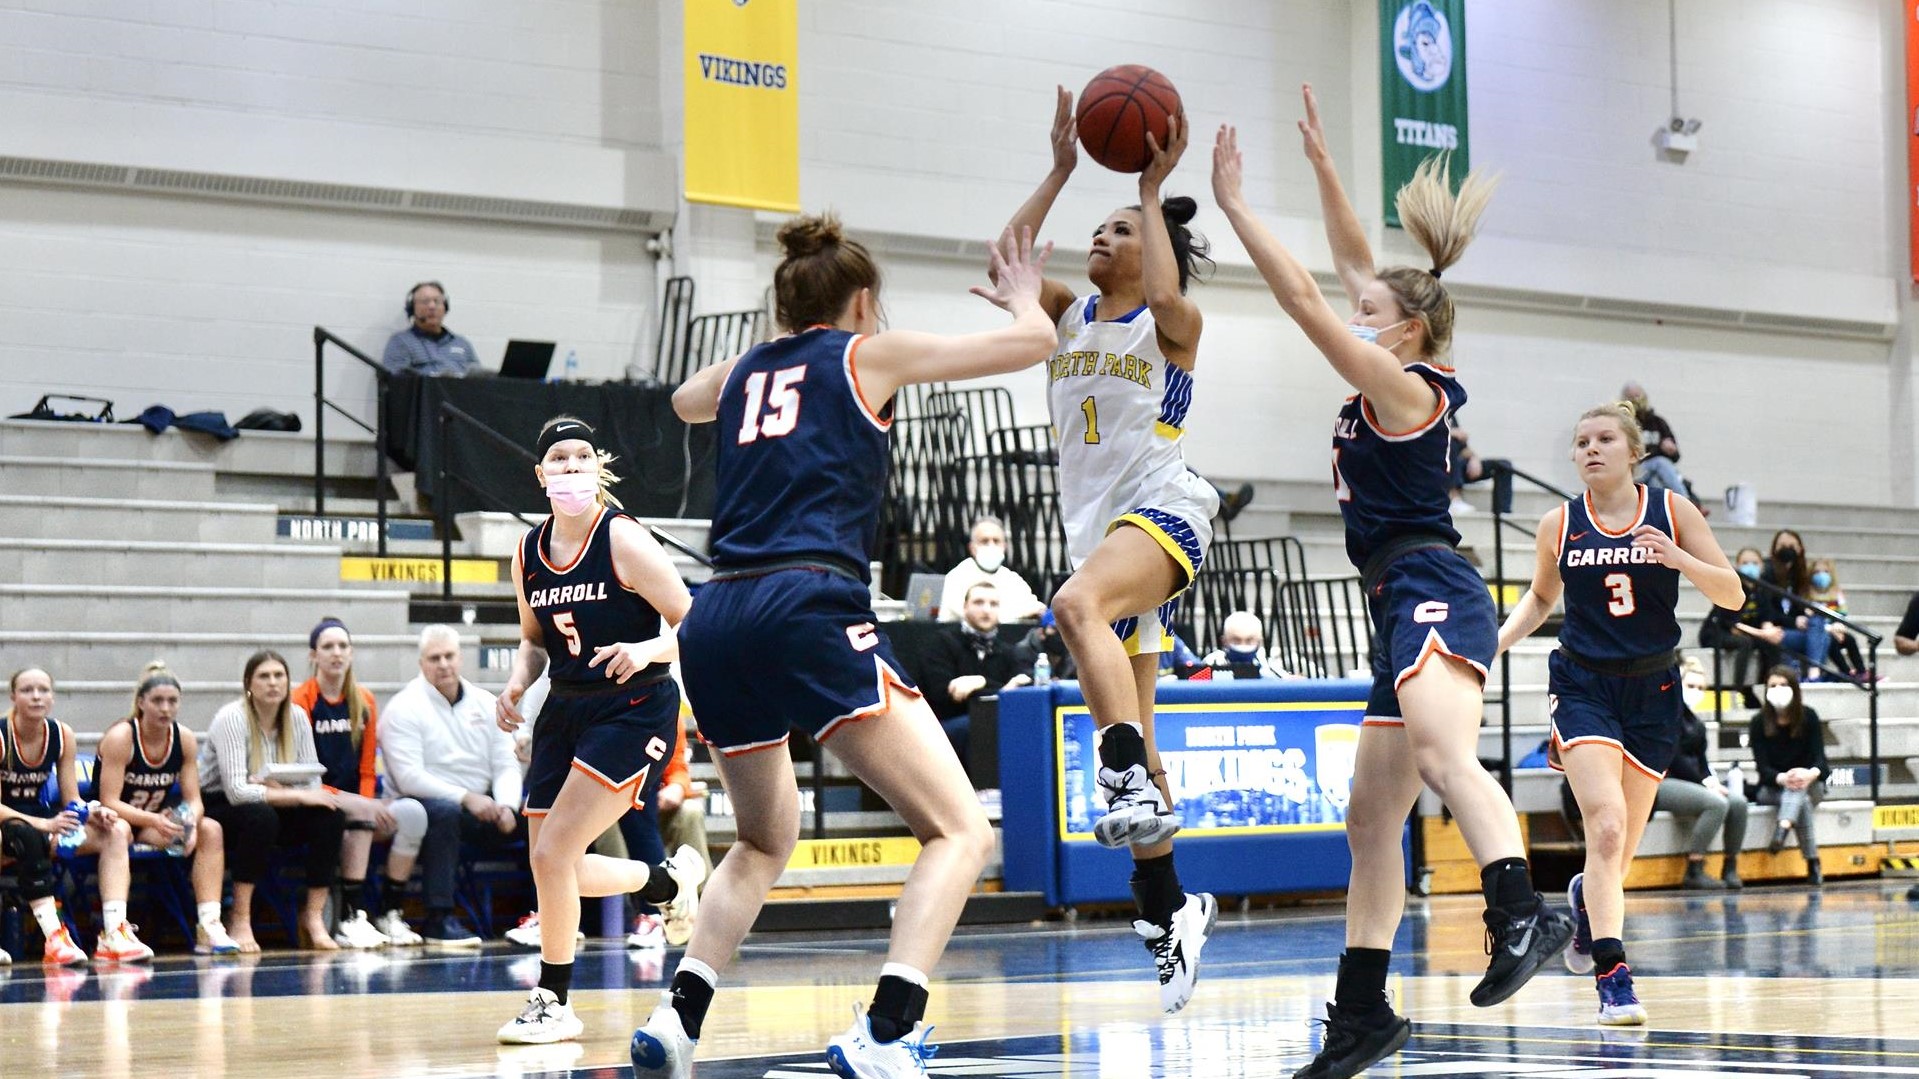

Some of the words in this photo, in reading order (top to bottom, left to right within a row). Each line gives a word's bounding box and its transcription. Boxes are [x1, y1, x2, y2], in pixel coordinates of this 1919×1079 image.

[698, 53, 787, 89] VIKINGS
[1394, 117, 1459, 150] TITANS
[1099, 352, 1153, 389] PARK
[737, 363, 808, 445] 15
[1081, 395, 1100, 445] 1
[290, 518, 342, 540] NORTH
[370, 563, 437, 581] VIKINGS
[1567, 547, 1662, 567] CARROL
[529, 582, 608, 608] CARROLL
[1604, 572, 1636, 618] 3
[552, 611, 582, 657] 5
[811, 842, 882, 865] VIKINGS
